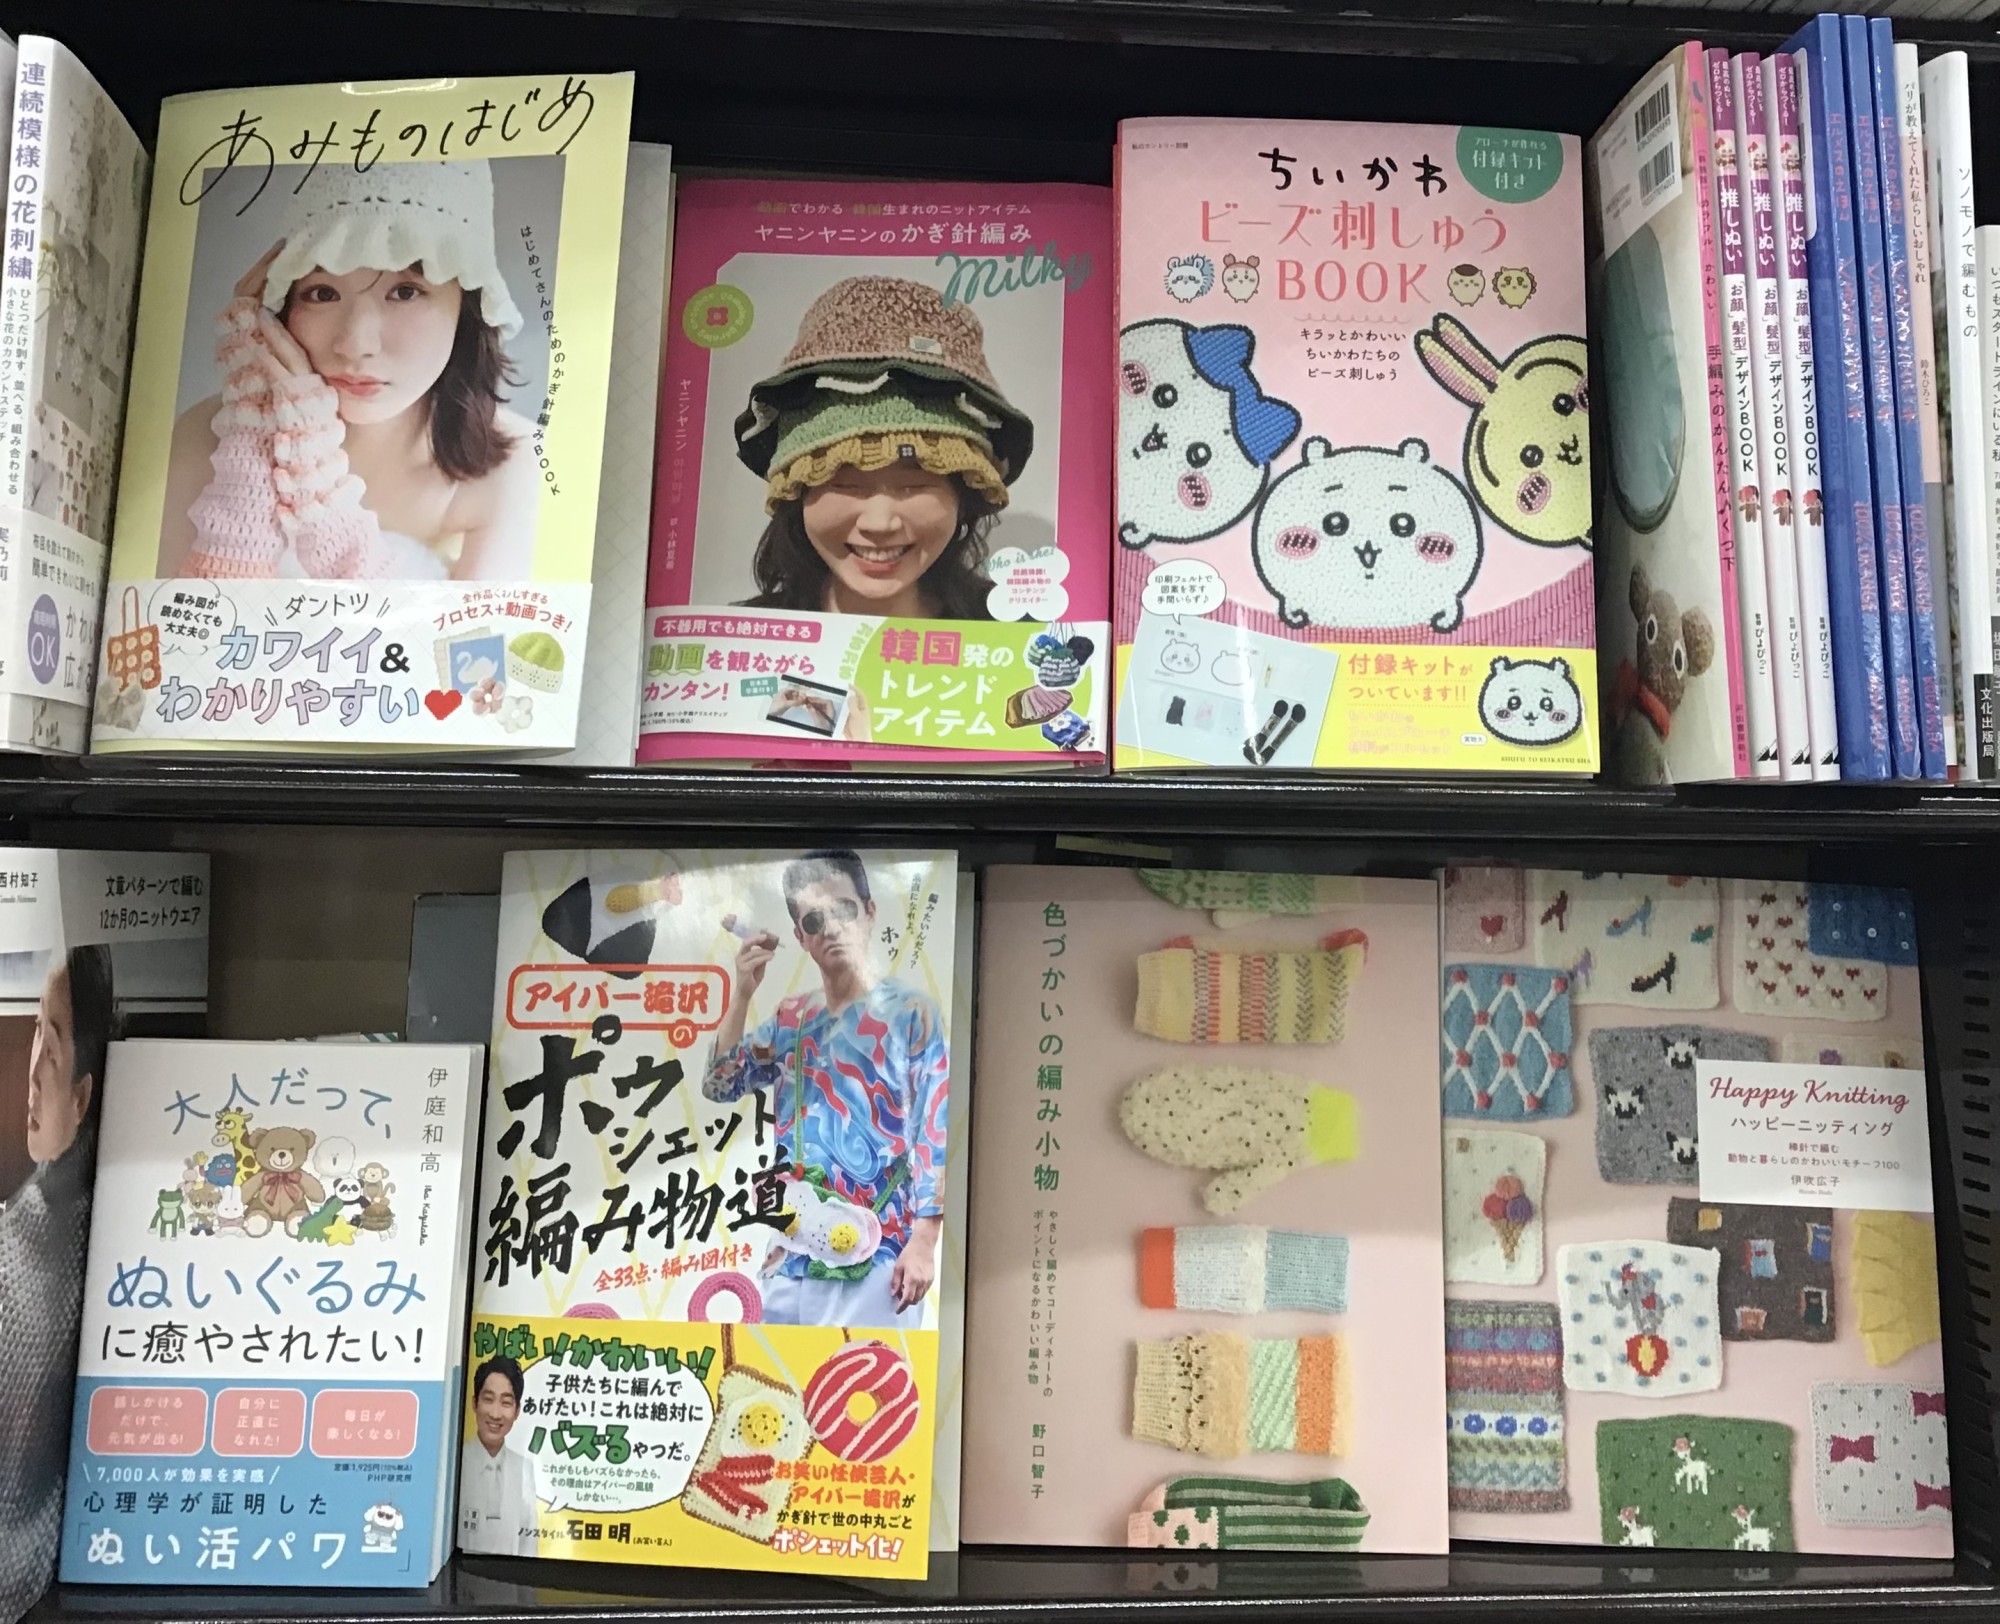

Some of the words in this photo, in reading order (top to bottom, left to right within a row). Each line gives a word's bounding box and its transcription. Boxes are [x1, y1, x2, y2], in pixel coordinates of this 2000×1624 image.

[179, 76, 595, 217] あみものはじめ
[8, 62, 47, 281] 連続模様の花刺繍
[1258, 147, 1448, 197] ちいかわ
[1495, 171, 1526, 190] 付き
[1904, 82, 1926, 283] パリが教えてくれた私らしいおしゃれ
[754, 221, 1032, 245] ヤニンヤニンのかぎ針編み
[1200, 200, 1507, 252] ビーズ刺しゅう
[1720, 189, 1743, 264] 推しぬい
[1754, 193, 1776, 266] 推しぬい
[1785, 194, 1807, 267] 推しぬい
[936, 240, 1095, 310] Milky
[1276, 259, 1431, 304] BOOK
[1300, 327, 1407, 343] キラッとかわいい
[520, 225, 566, 496] はじめてさんのためのかぎ針編みBOOK
[1306, 347, 1400, 362] ちいかわたちの
[1307, 367, 1398, 382] ビーズ刺しゅう
[674, 379, 692, 452] ヤニンヤニン
[1958, 167, 1978, 338] ソノモノで編むもの
[1980, 688, 1995, 757] 文化出版局
[160, 604, 223, 627] 読めなくても
[173, 592, 219, 610] 編み図が
[285, 592, 372, 620] ダントツ
[662, 619, 811, 639] 不器用でも絶対できる
[880, 627, 1014, 667] 韓国発の
[31, 631, 56, 668] OK
[647, 643, 815, 675] 動画を観ながら
[1348, 652, 1473, 677] 付録キットが
[156, 675, 420, 727] わかりやすい
[644, 680, 729, 701] カンタン!
[881, 669, 998, 705] トレンド
[873, 706, 996, 737] アイテム
[105, 875, 204, 897] 文章パターンで編む
[1033, 901, 1067, 1192] 色づかいの編み小物
[164, 1067, 393, 1139] 大人だって、
[1709, 1076, 1798, 1109] Happy
[1803, 1079, 1909, 1114] Knitting
[420, 1067, 448, 1173] 伊庭和高
[1731, 1116, 1894, 1137] ハッピーニッティング
[1790, 1174, 1841, 1187] 伊吹広子
[484, 1144, 797, 1287] 編み物道
[107, 1255, 427, 1315] ぬいぐるみ
[1027, 1209, 1044, 1385] ポイントになるかわいい編み物
[1043, 1209, 1058, 1398] やさしく編めてコーディネートの
[101, 1320, 424, 1364] に癒やされたい!
[239, 1397, 280, 1410] 自分に
[545, 1374, 683, 1398] 子供たちに編んで
[236, 1415, 279, 1429] 正直に
[344, 1409, 386, 1423] 毎日が
[97, 1467, 265, 1484] 7,000人が効果を実感
[1030, 1423, 1047, 1500] 野口智子
[84, 1490, 328, 1516] 心理学が証明した
[776, 1509, 914, 1530] かぎ針で世の中丸ごと
[518, 1526, 564, 1539] ノンスタイル
[567, 1520, 603, 1540] 石田
[608, 1523, 631, 1544] 明
[772, 1527, 904, 1562] ポシェット化!
